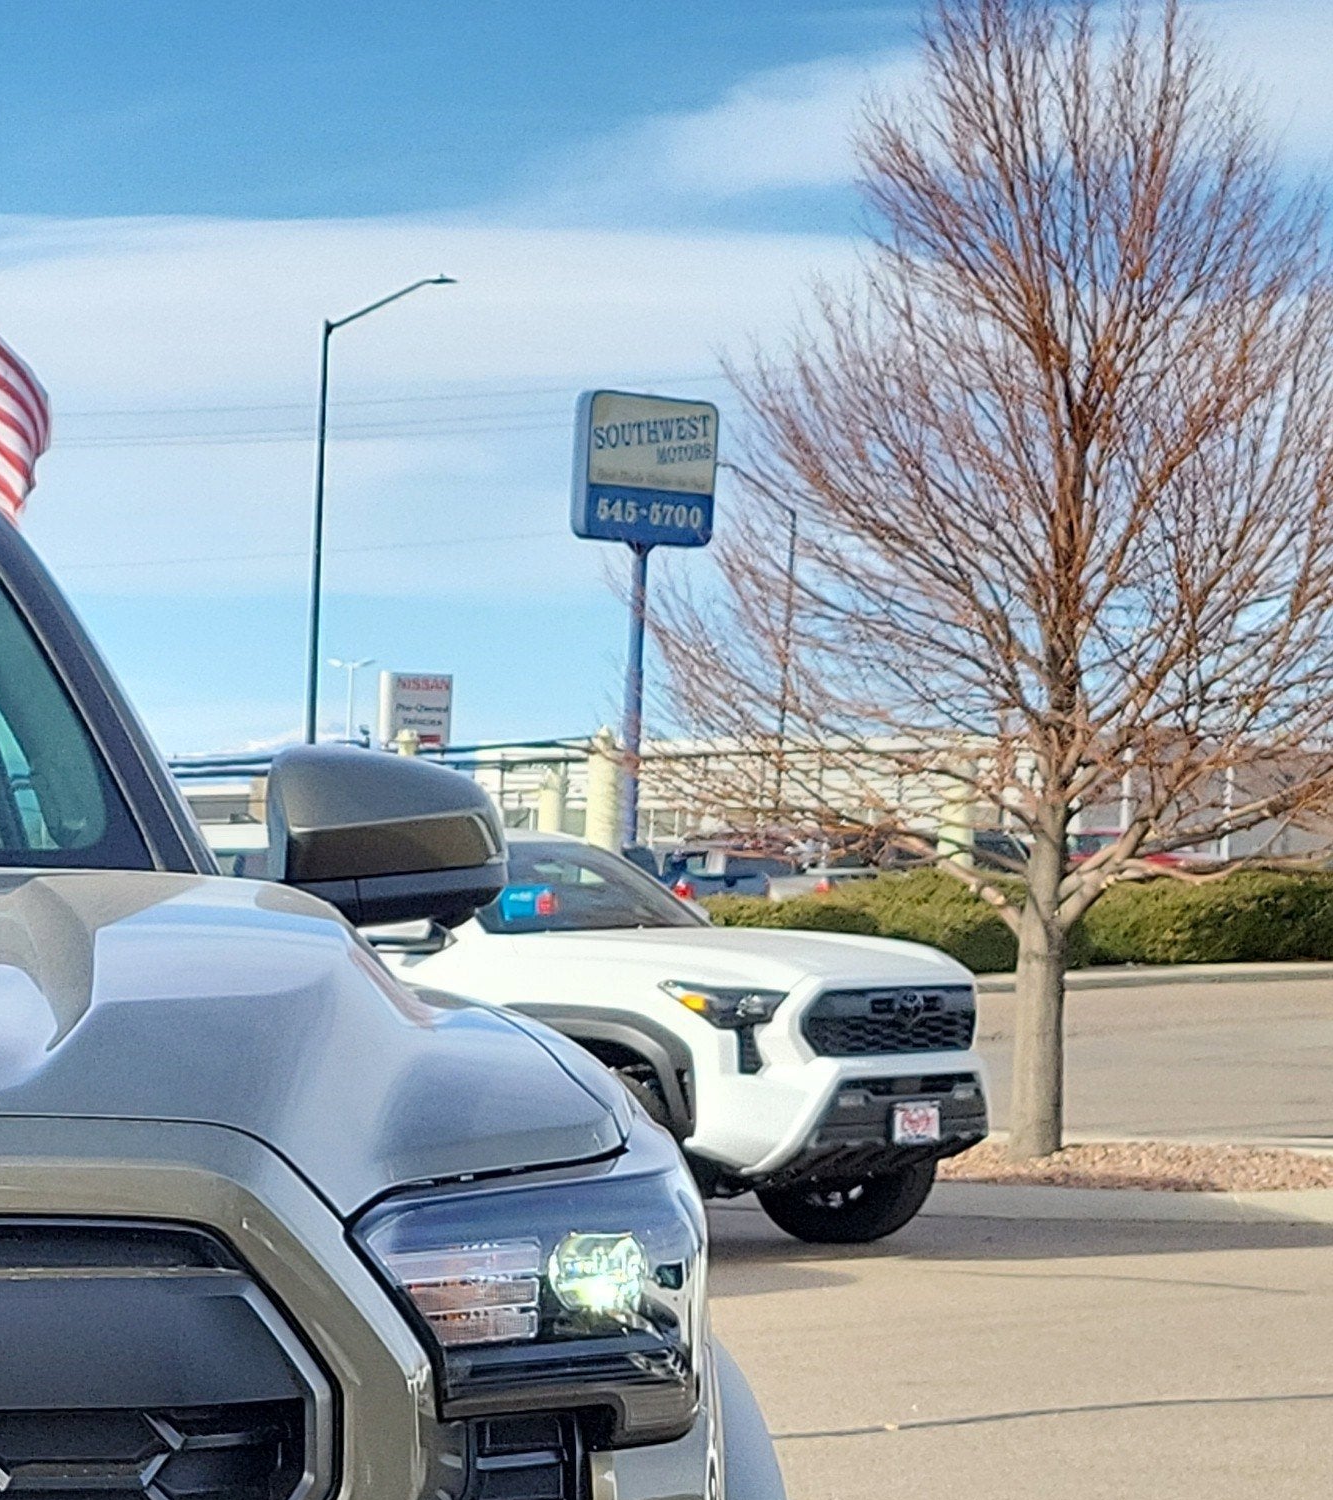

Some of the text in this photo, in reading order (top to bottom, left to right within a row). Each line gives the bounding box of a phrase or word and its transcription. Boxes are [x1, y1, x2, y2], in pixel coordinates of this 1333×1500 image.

[594, 415, 711, 449] SOUTHWEST
[657, 443, 713, 465] MOTORS
[597, 498, 703, 528] 545-5700
[396, 676, 450, 691] NISSAN
